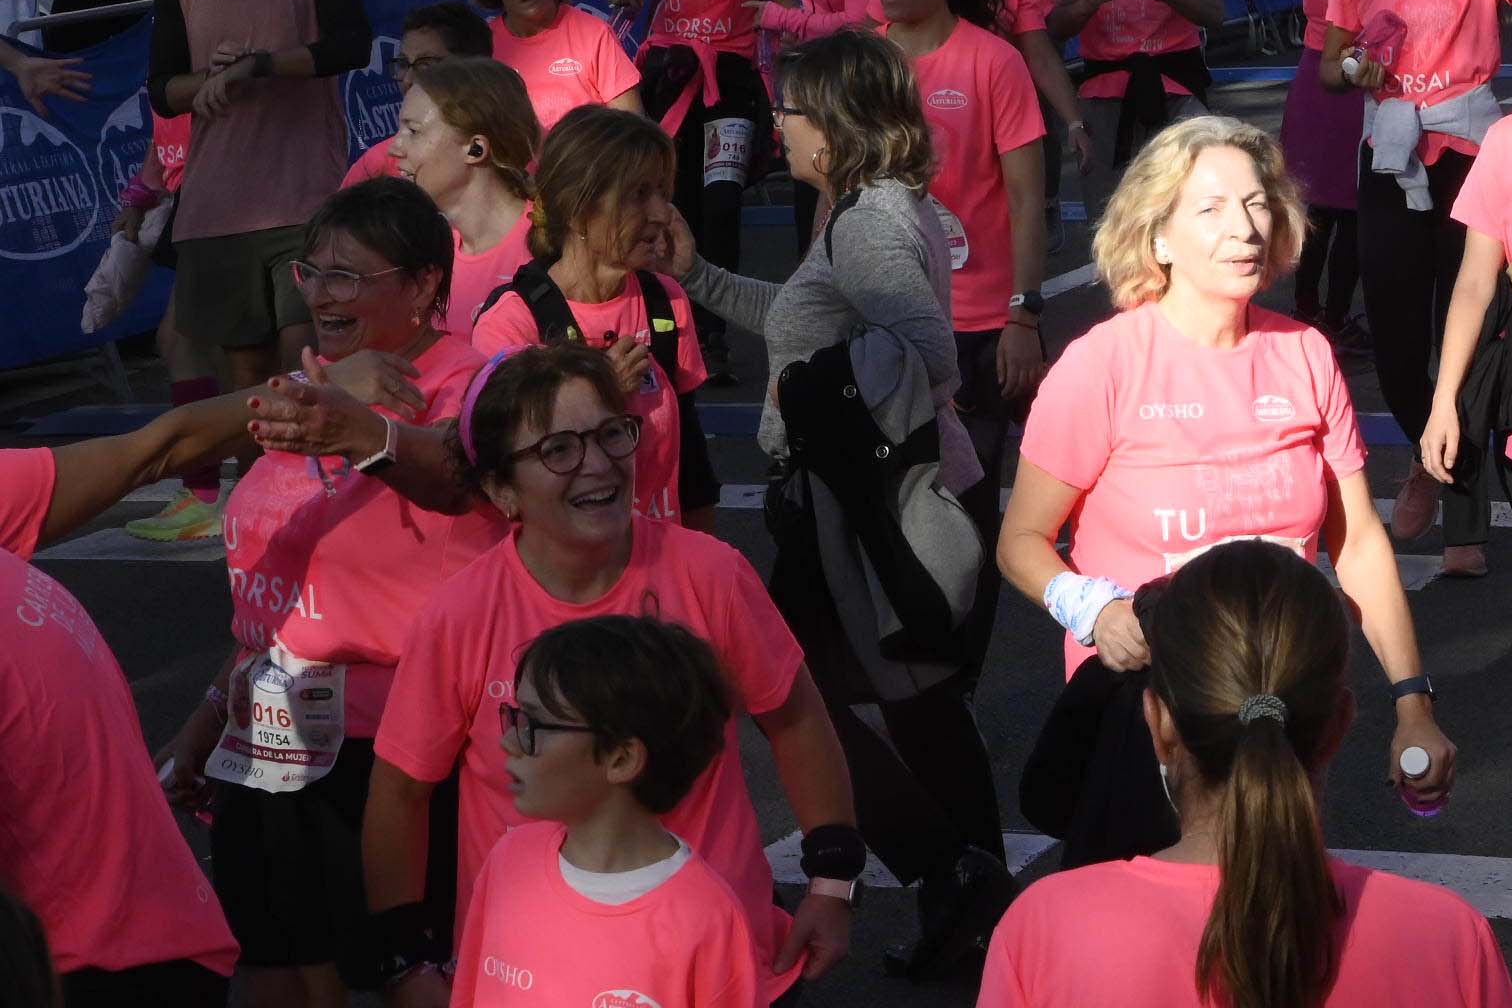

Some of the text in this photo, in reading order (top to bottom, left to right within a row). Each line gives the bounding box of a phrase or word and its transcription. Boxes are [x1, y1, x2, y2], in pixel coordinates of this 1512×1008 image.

[1139, 403, 1205, 420] OYSHO
[1154, 508, 1207, 542] TU
[253, 702, 292, 728] 016
[258, 730, 291, 746] 19754
[274, 752, 284, 760] LA
[285, 753, 312, 762] MUJER
[222, 759, 264, 779] OYSHO
[484, 956, 534, 991] OYSHO
